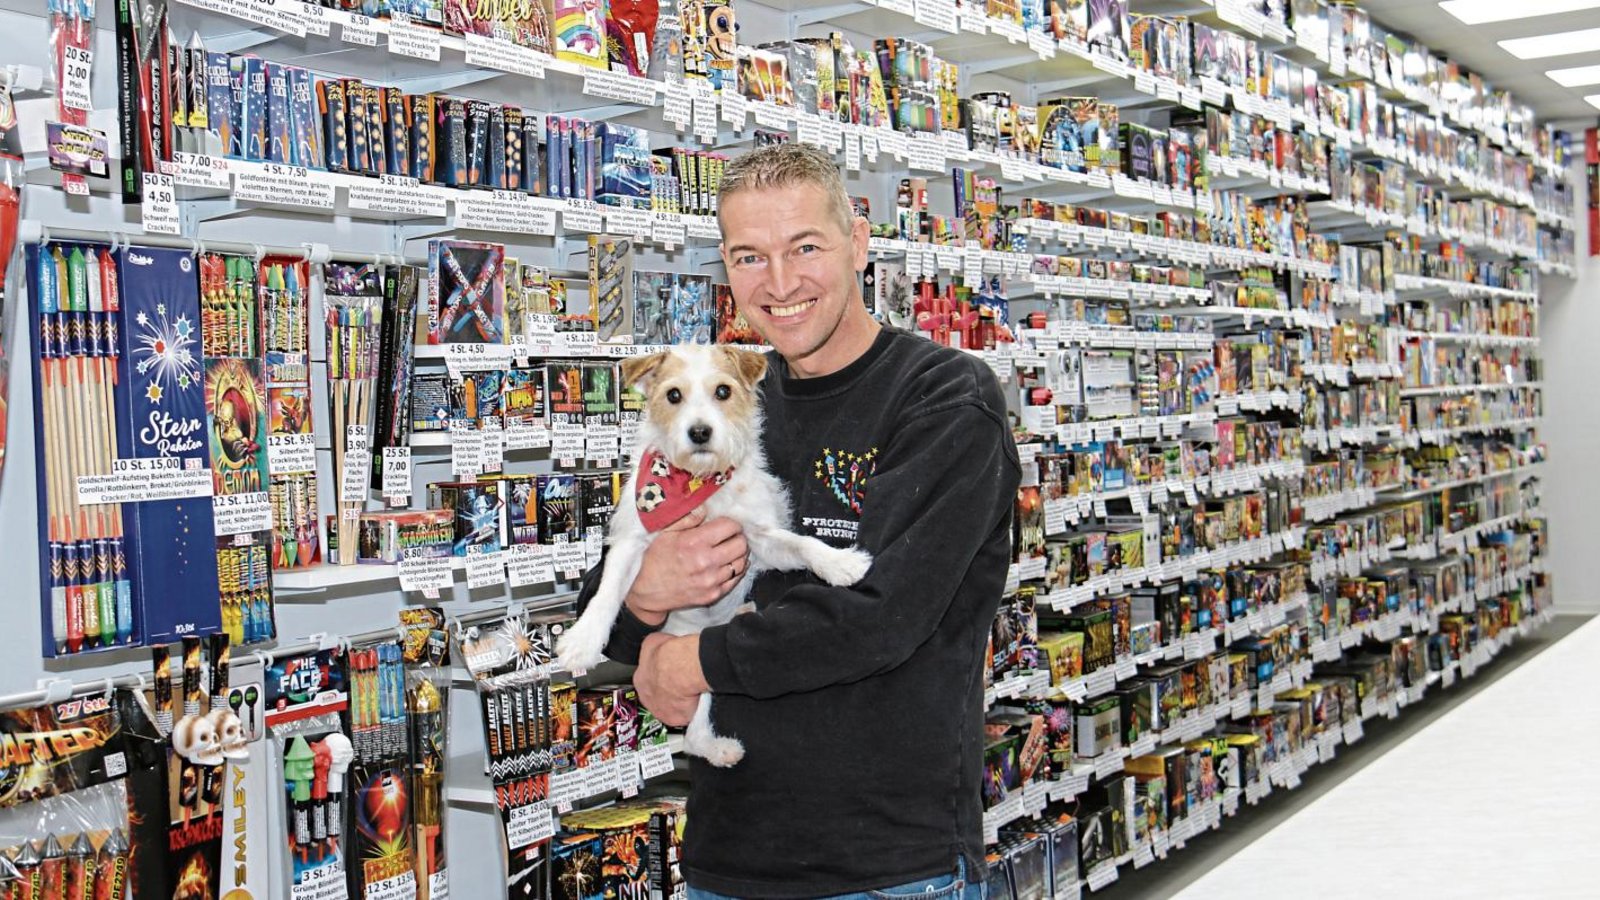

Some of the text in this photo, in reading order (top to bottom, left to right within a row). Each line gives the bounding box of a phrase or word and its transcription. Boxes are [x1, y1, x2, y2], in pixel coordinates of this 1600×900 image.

[303, 4, 324, 16] 8,50
[265, 18, 299, 34] Crackling
[66, 47, 92, 65] 20 St.
[67, 65, 87, 80] 2,00
[174, 152, 210, 167] St. 7,00
[212, 160, 228, 170] 524
[264, 164, 307, 178] 4 St. 7,50
[144, 174, 173, 187] 50 St.
[380, 176, 420, 188] 5 St. 14,90
[68, 183, 88, 194] 532
[149, 191, 171, 203] 4,50
[147, 223, 176, 232] Crackling
[566, 334, 570, 342] 4
[570, 334, 580, 343] St.
[450, 344, 485, 356] 4 St. 4,50
[610, 346, 614, 354] 4
[615, 346, 624, 355] St.
[140, 410, 202, 445] Stern
[348, 426, 366, 436] 6 St.
[268, 437, 280, 446] 12
[284, 436, 298, 445] St.
[348, 440, 366, 450] 3,90
[157, 438, 203, 457] Raketen
[386, 448, 409, 458] 25 St.
[114, 458, 179, 470] 10 St. 15,00
[388, 462, 406, 472] 7,00
[214, 494, 268, 507] 12 St. 11,00
[404, 548, 422, 558] 8,80
[293, 657, 316, 671] THE
[280, 669, 323, 692] FACE
[57, 698, 110, 720] 27 Stk
[486, 698, 496, 730] RAKETE
[0, 727, 106, 768] AFTER
[511, 810, 516, 819] 6
[518, 808, 529, 818] St.
[232, 765, 247, 888] SMILEY
[302, 871, 310, 882] 3
[313, 868, 326, 880] St.
[292, 882, 317, 893] Grüne
[368, 884, 380, 894] 12
[382, 880, 394, 891] St.
